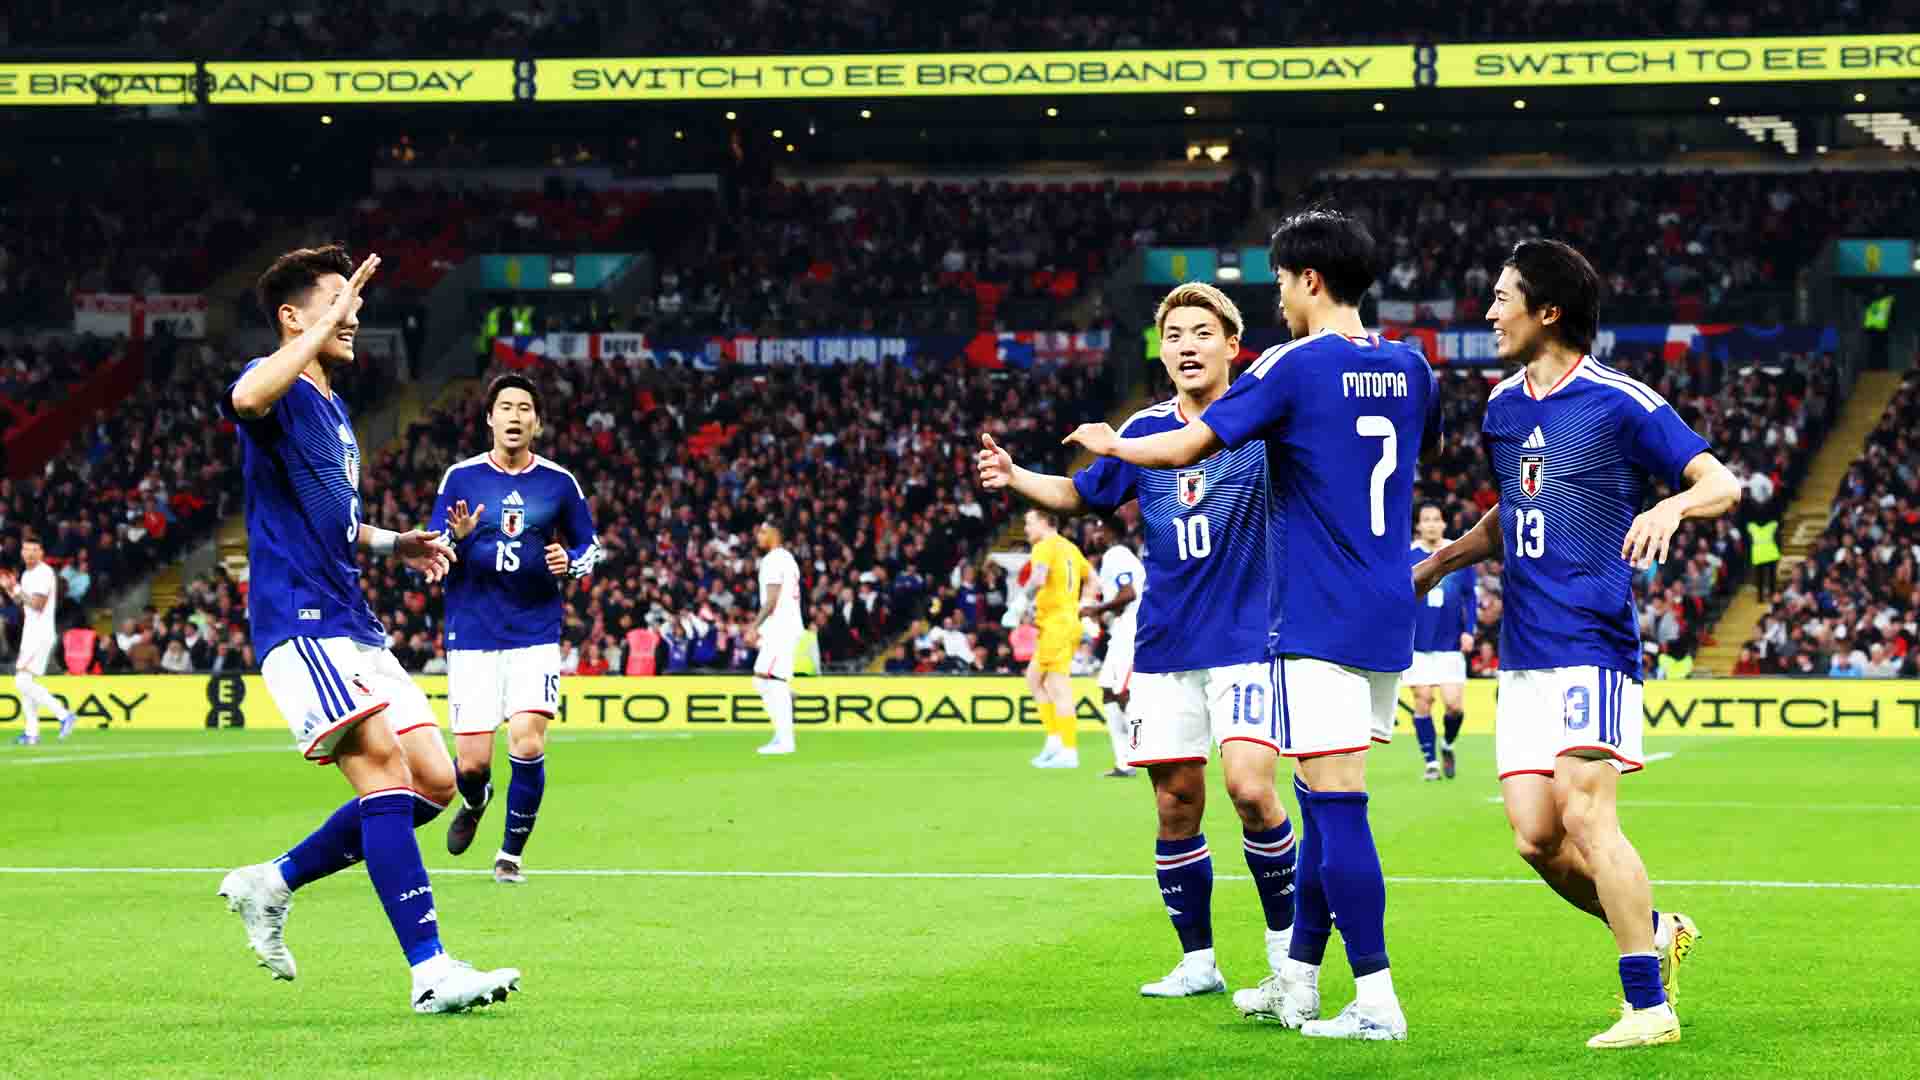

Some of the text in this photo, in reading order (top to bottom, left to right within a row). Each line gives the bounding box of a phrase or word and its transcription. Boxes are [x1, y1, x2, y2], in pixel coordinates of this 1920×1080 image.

[571, 57, 1371, 90] SWITCH TO EE BROADBAND TODAY
[1474, 50, 1676, 76] SWITCH
[1687, 49, 1751, 72] TO
[1763, 48, 1827, 71] EE
[325, 71, 473, 92] TODAY
[1342, 372, 1408, 398] MITOMA
[1356, 415, 1397, 537] 7
[1172, 514, 1212, 561] 10
[1515, 508, 1544, 559] 13
[495, 540, 522, 572] 15
[584, 694, 670, 723] TO
[686, 694, 772, 724] EE
[1232, 683, 1265, 724] 10
[1562, 686, 1590, 730] 3
